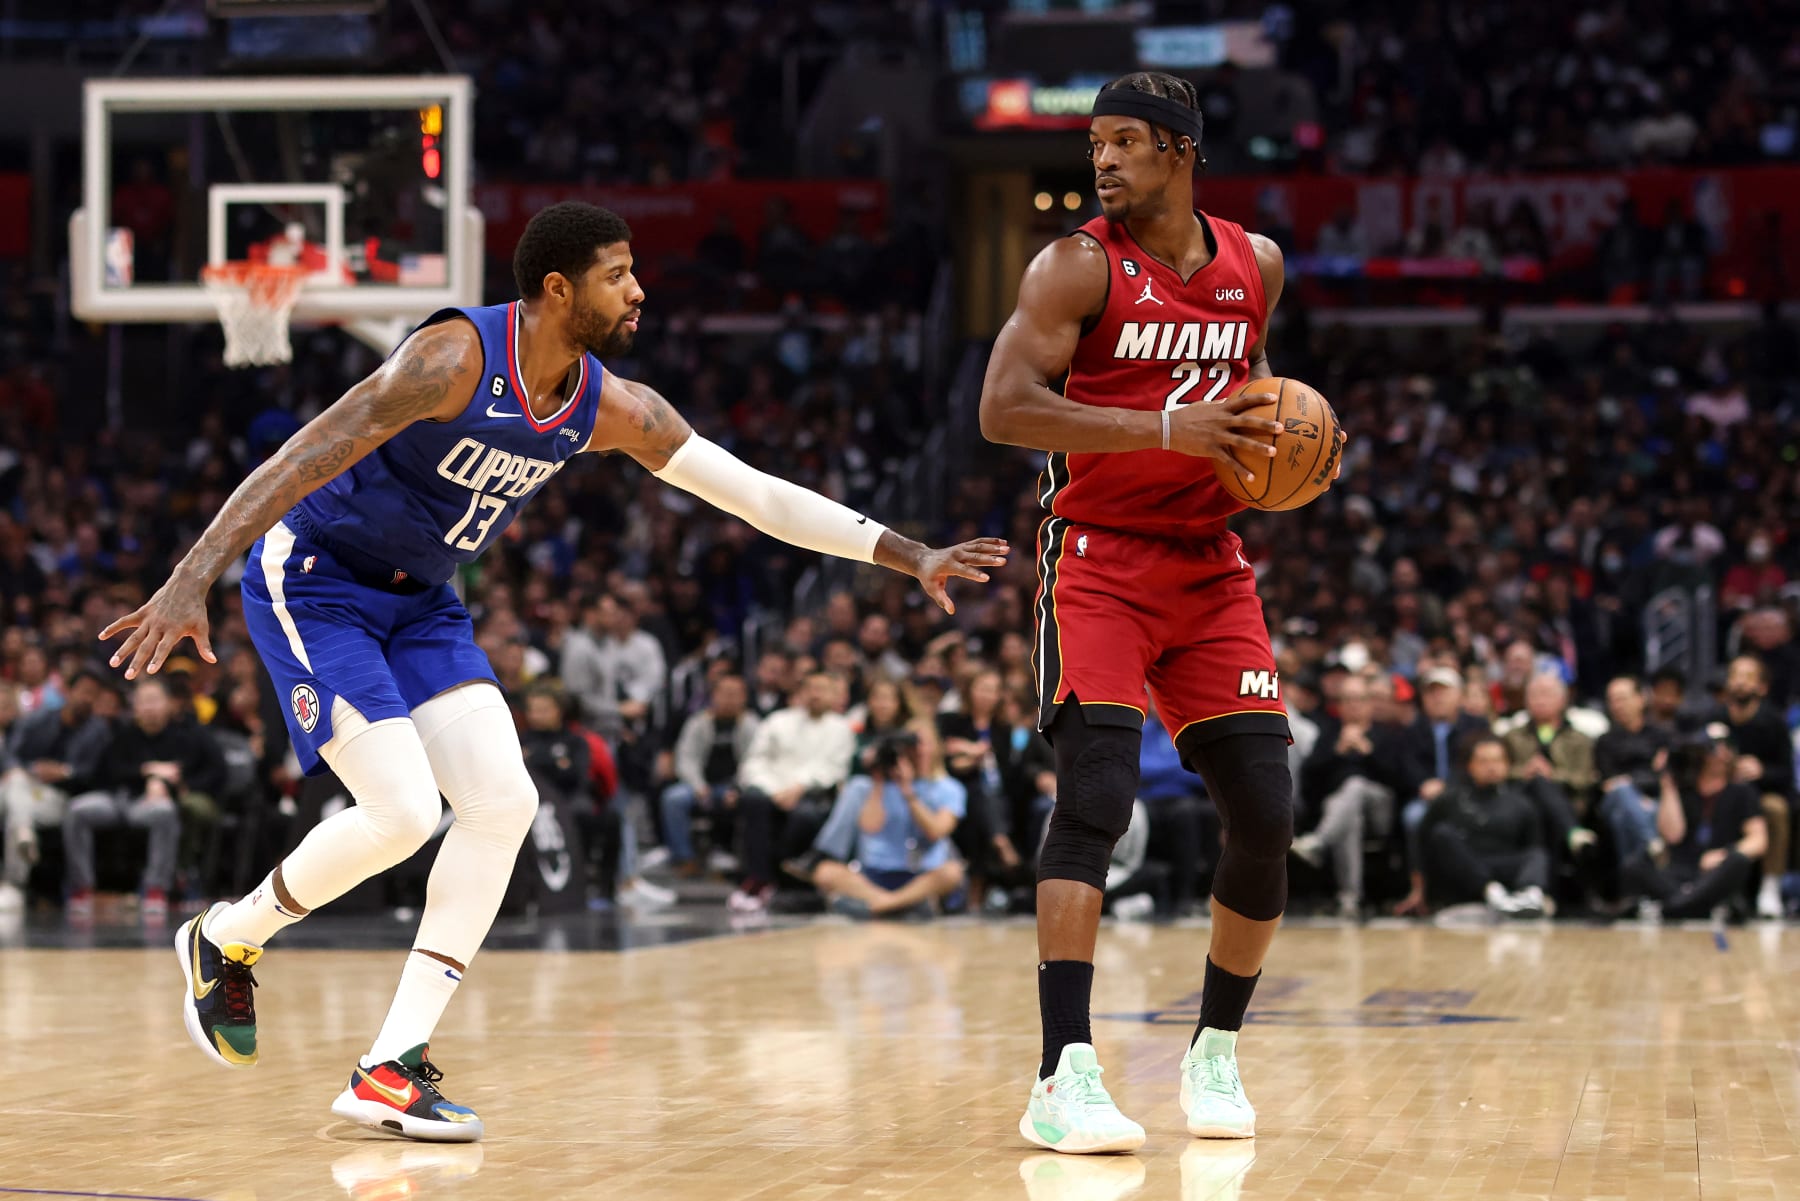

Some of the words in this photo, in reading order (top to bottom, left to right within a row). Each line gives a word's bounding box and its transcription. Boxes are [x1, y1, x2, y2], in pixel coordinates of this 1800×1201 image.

[1122, 260, 1136, 276] 6
[1113, 322, 1248, 360] MIAMI
[492, 376, 504, 396] 6
[1164, 361, 1232, 412] 22
[559, 427, 580, 443] oney
[443, 491, 508, 552] 13
